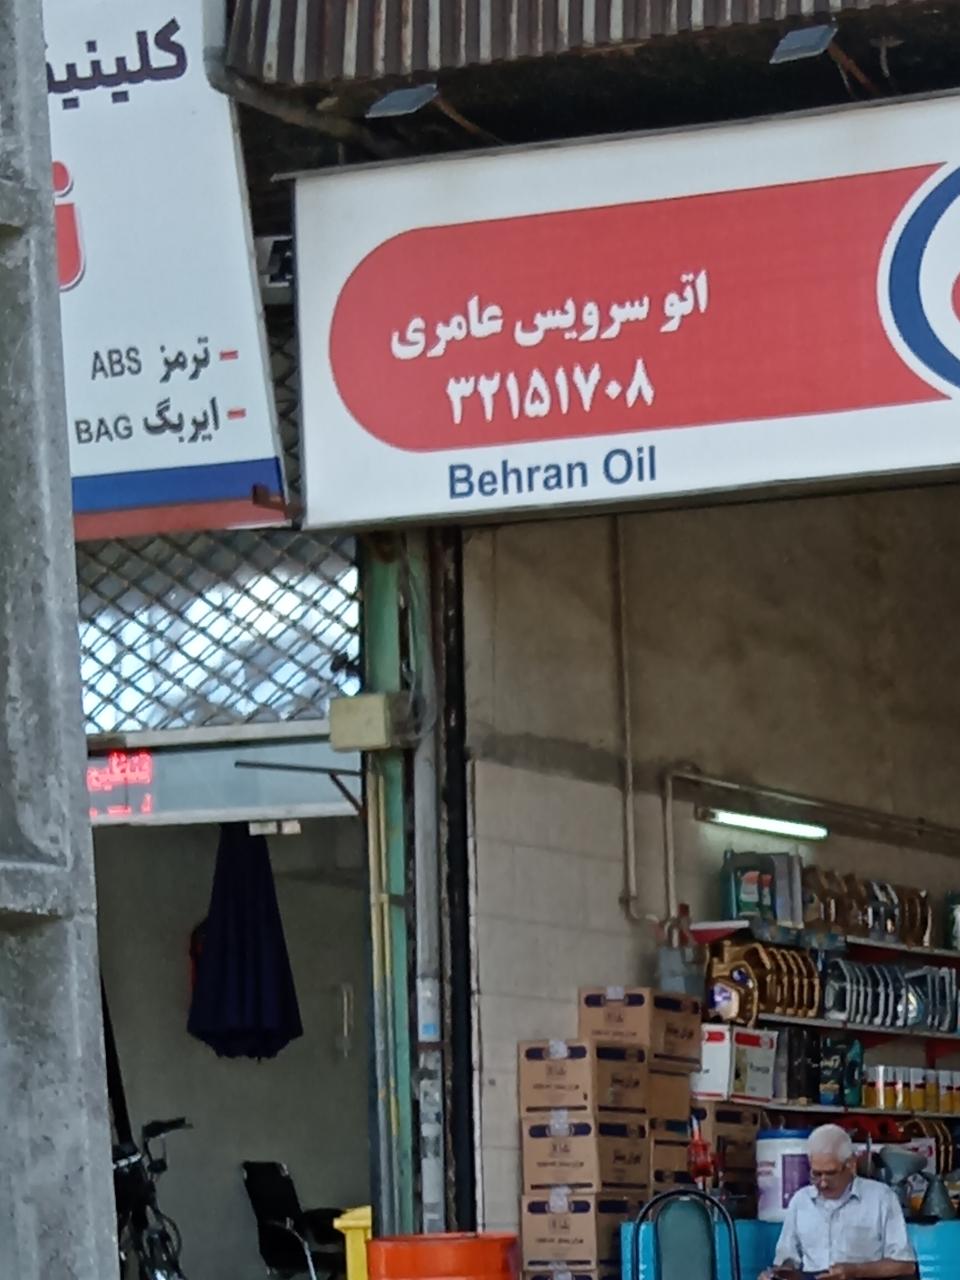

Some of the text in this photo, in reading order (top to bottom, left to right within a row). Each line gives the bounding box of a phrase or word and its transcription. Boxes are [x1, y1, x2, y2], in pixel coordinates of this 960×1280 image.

[47, 18, 188, 110] کلینی
[389, 270, 710, 361] اتو سرویس عامری
[90, 337, 210, 385] ترمز ABS
[75, 398, 220, 443] ایربگ BAG
[446, 358, 654, 426] ۳۲۱۵۱۷۰۸
[448, 448, 657, 500] Behran Oil
